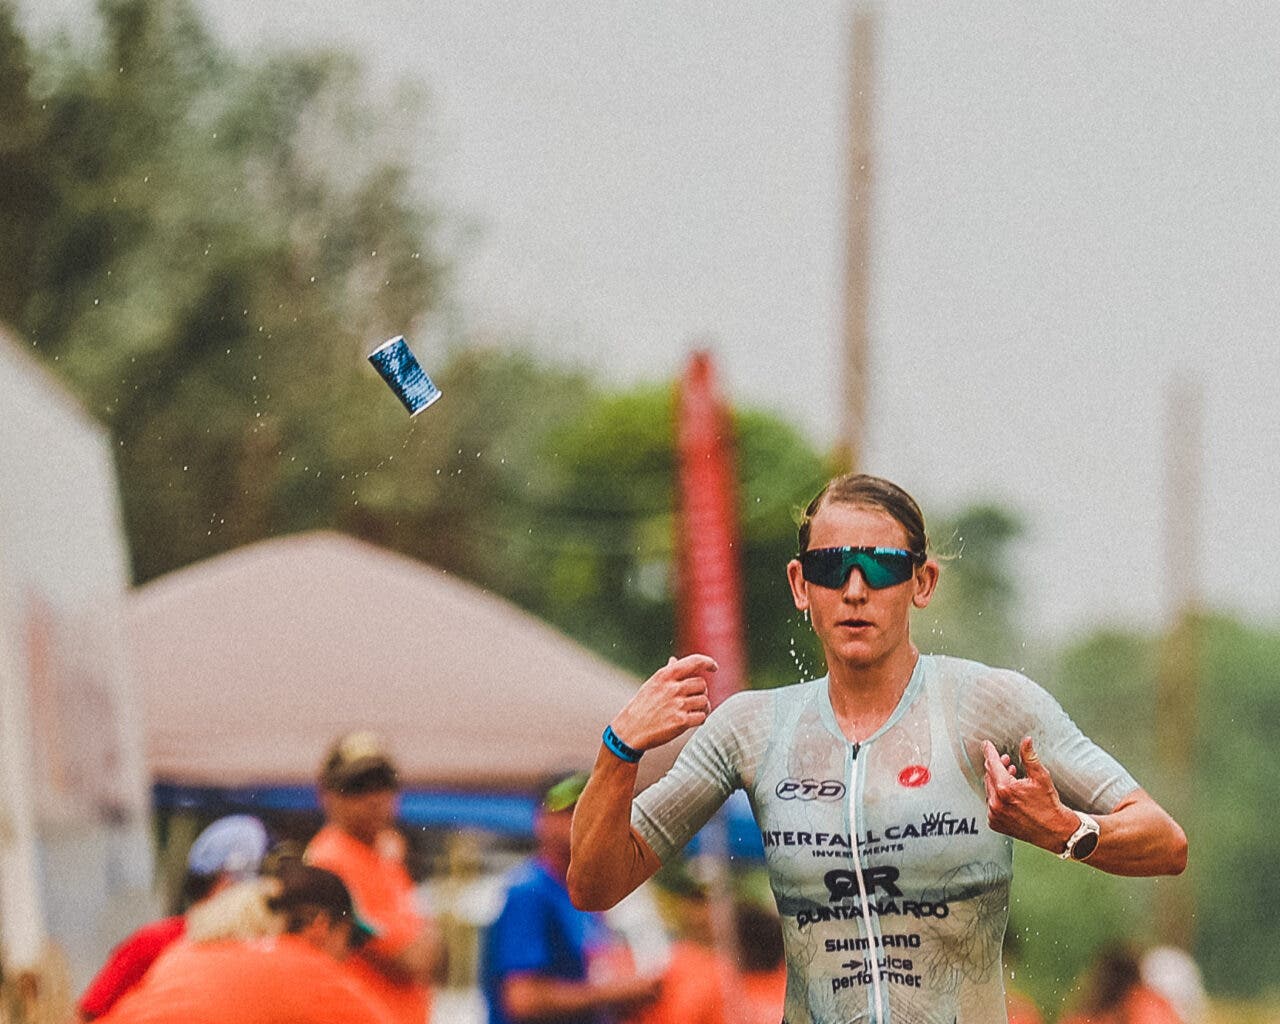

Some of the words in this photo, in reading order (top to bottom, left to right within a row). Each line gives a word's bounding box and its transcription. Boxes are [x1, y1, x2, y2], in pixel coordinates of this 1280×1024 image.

[885, 817, 978, 839] CAPITAL
[824, 866, 904, 902] QR
[825, 934, 921, 952] SHIMANO
